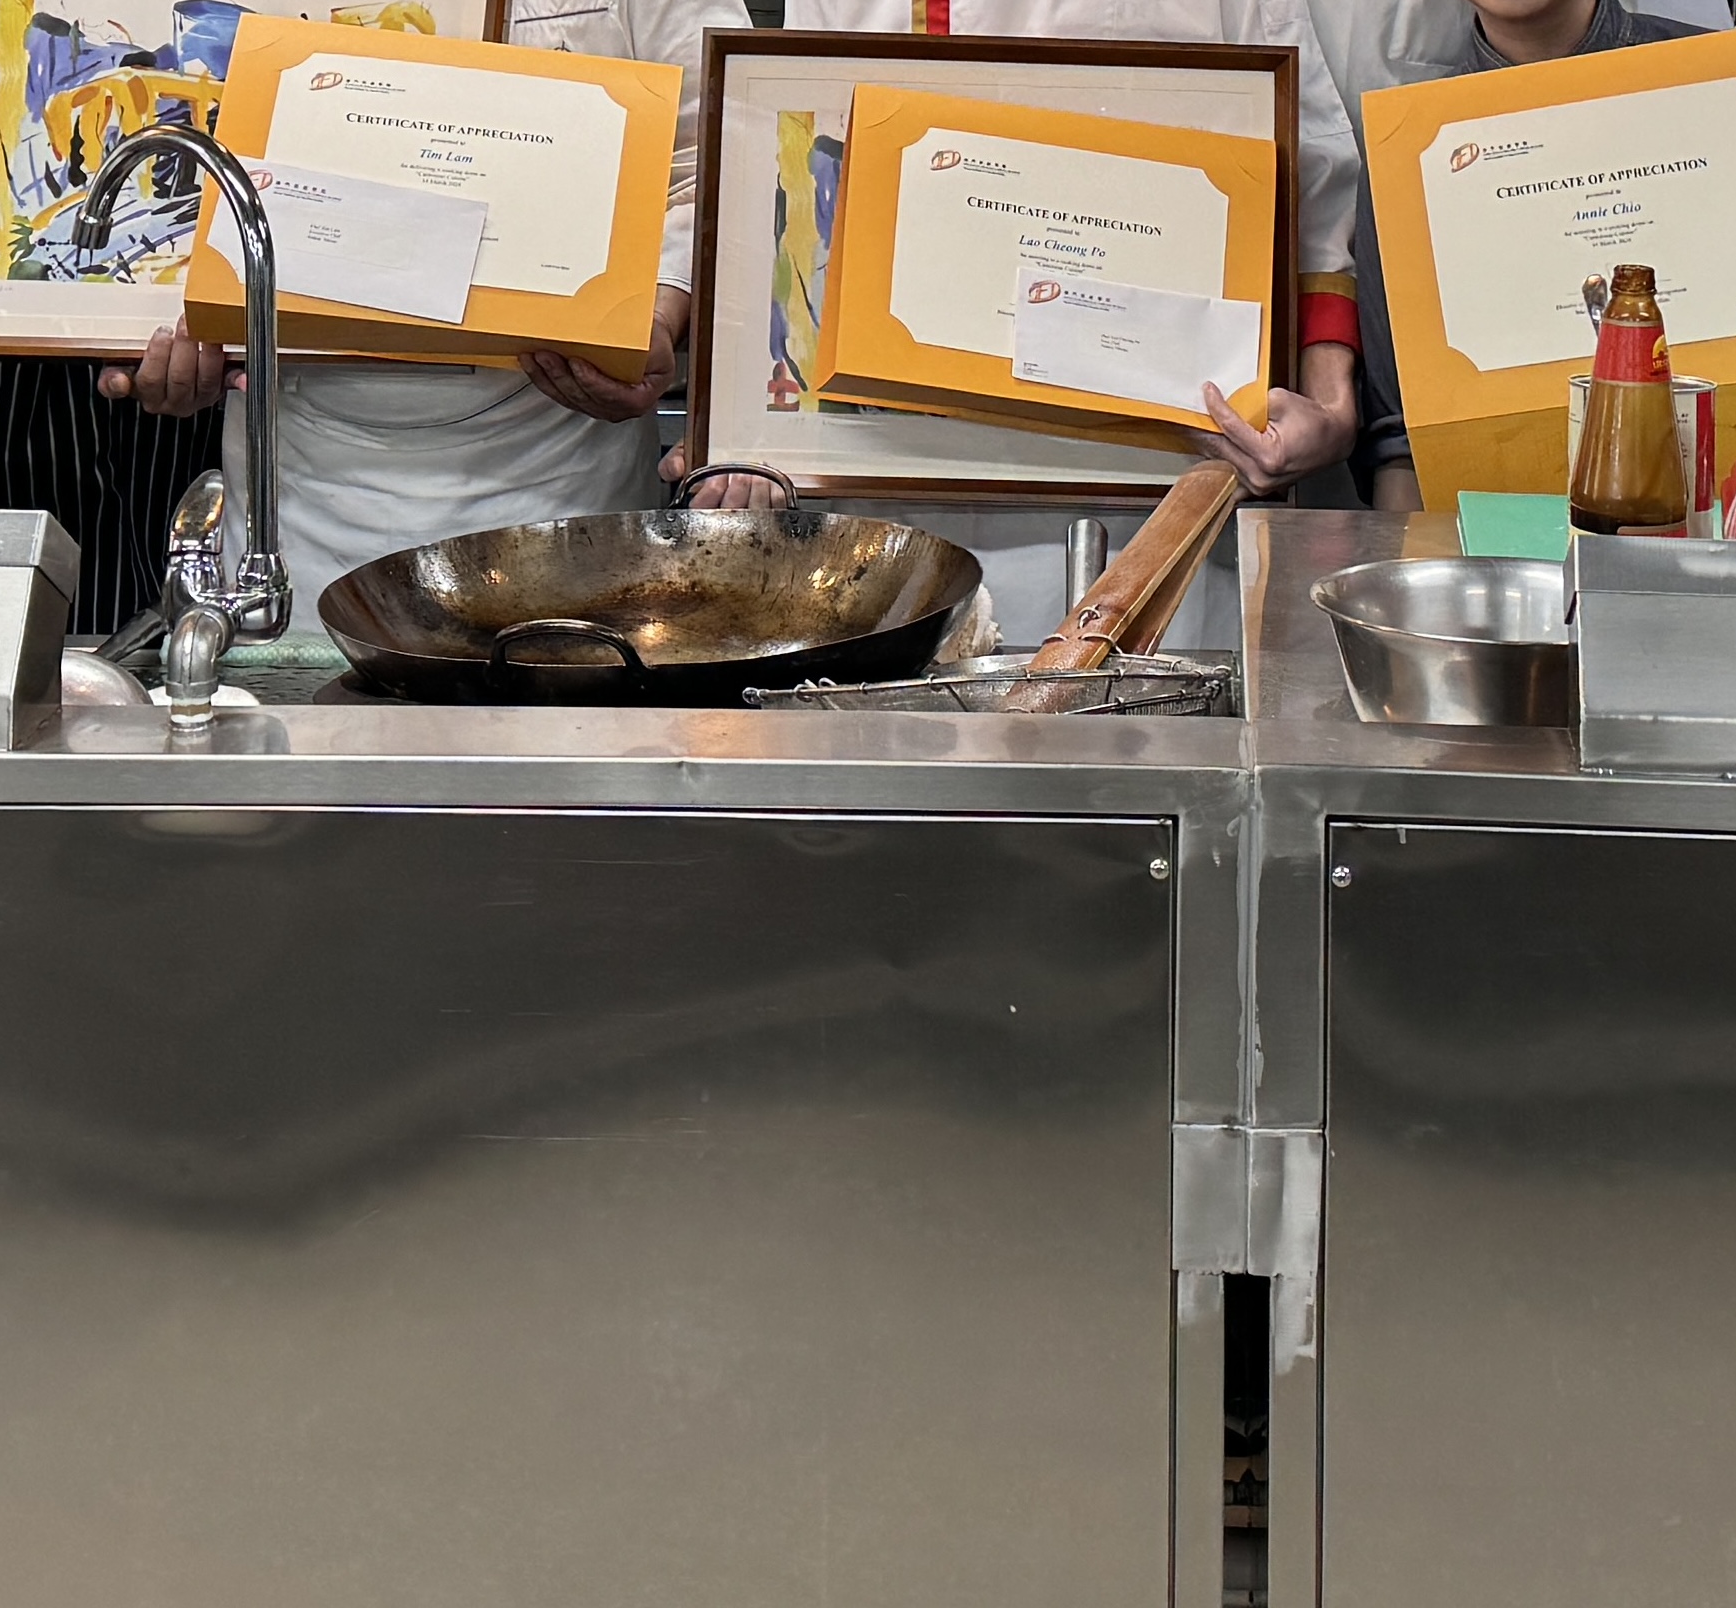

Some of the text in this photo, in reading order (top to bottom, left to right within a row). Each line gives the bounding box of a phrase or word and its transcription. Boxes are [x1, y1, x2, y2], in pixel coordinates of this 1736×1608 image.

[346, 111, 555, 145] CERTIFICATE OF APPRECIATION
[419, 148, 474, 164] Tim Lam
[1496, 157, 1709, 200] CERTIFICATE OF APPRECIATION
[966, 196, 1163, 237] CERTIFICATE OF APPRECIATION
[1572, 201, 1642, 222] Annie Chio
[1018, 234, 1107, 258] Lao Cheong Po
